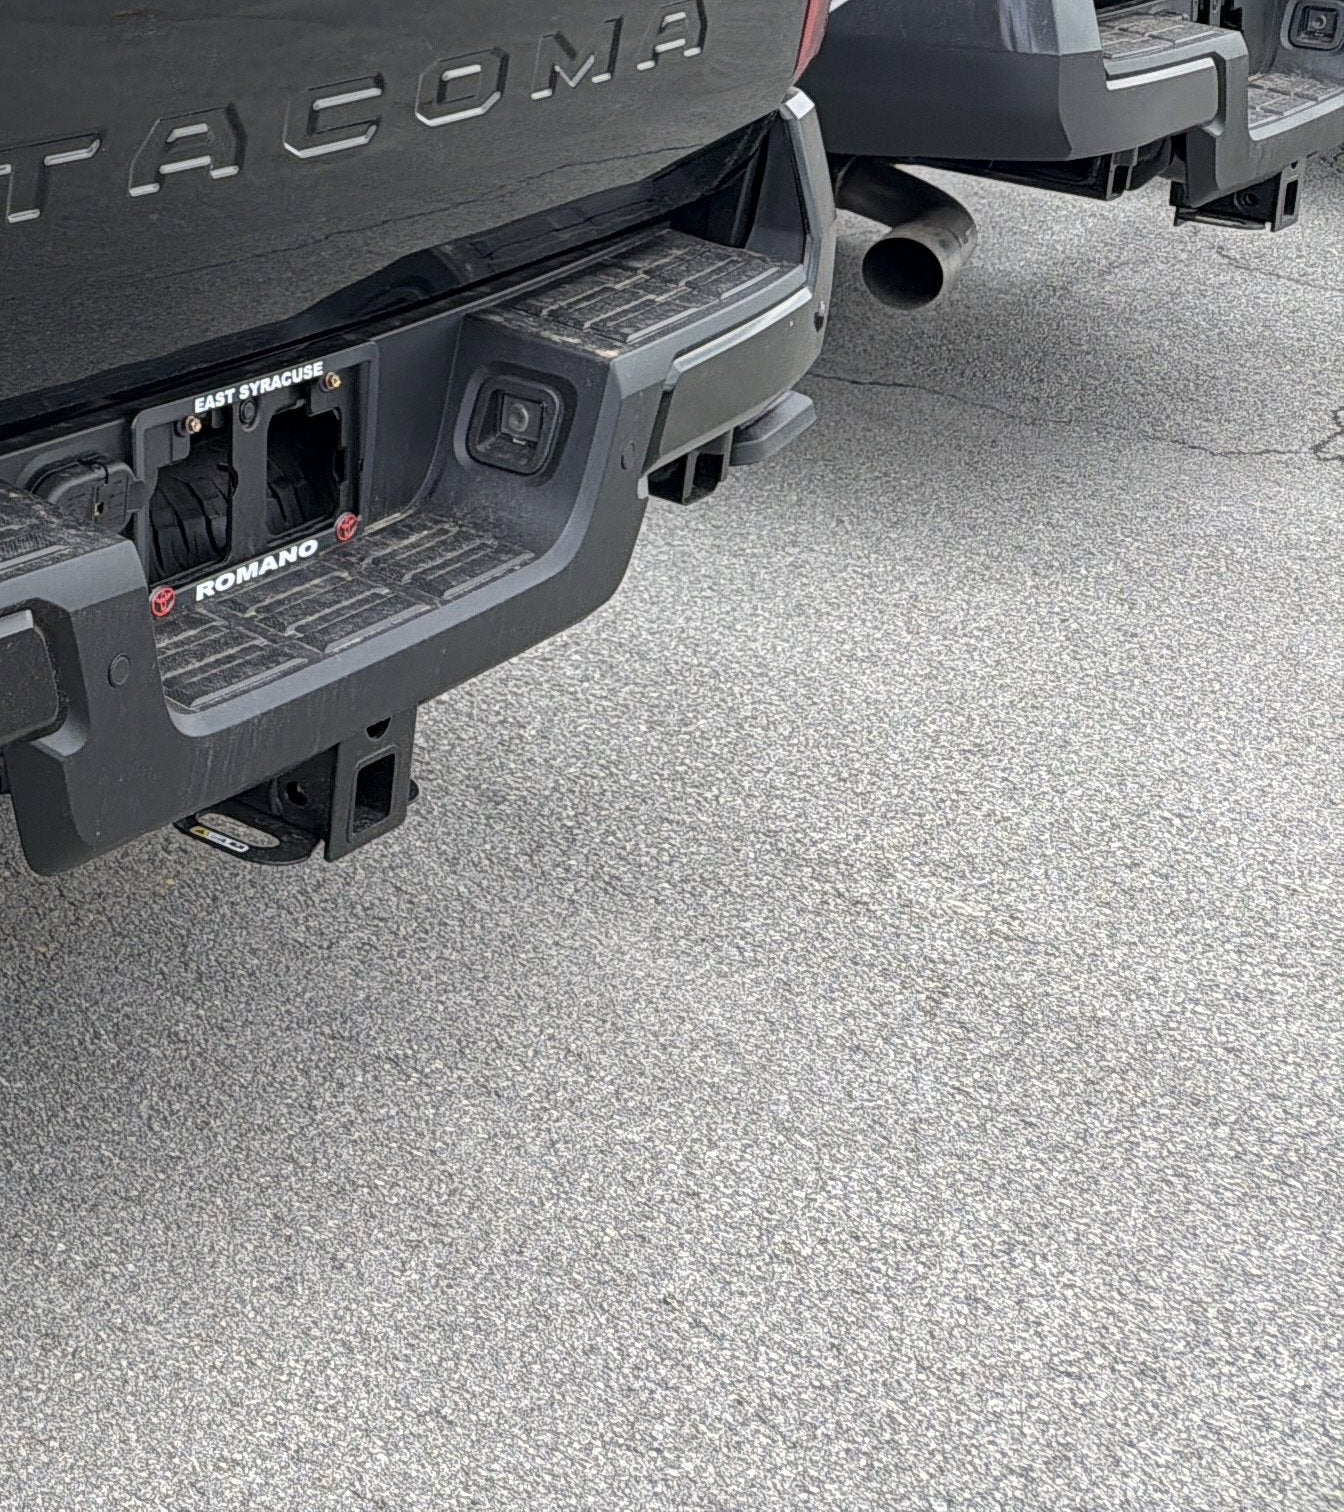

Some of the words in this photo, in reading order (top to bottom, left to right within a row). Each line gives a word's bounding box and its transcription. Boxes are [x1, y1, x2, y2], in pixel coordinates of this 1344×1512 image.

[194, 388, 237, 414] EAST
[238, 361, 324, 400] SYRACUSE
[195, 539, 319, 601] ROMANO
